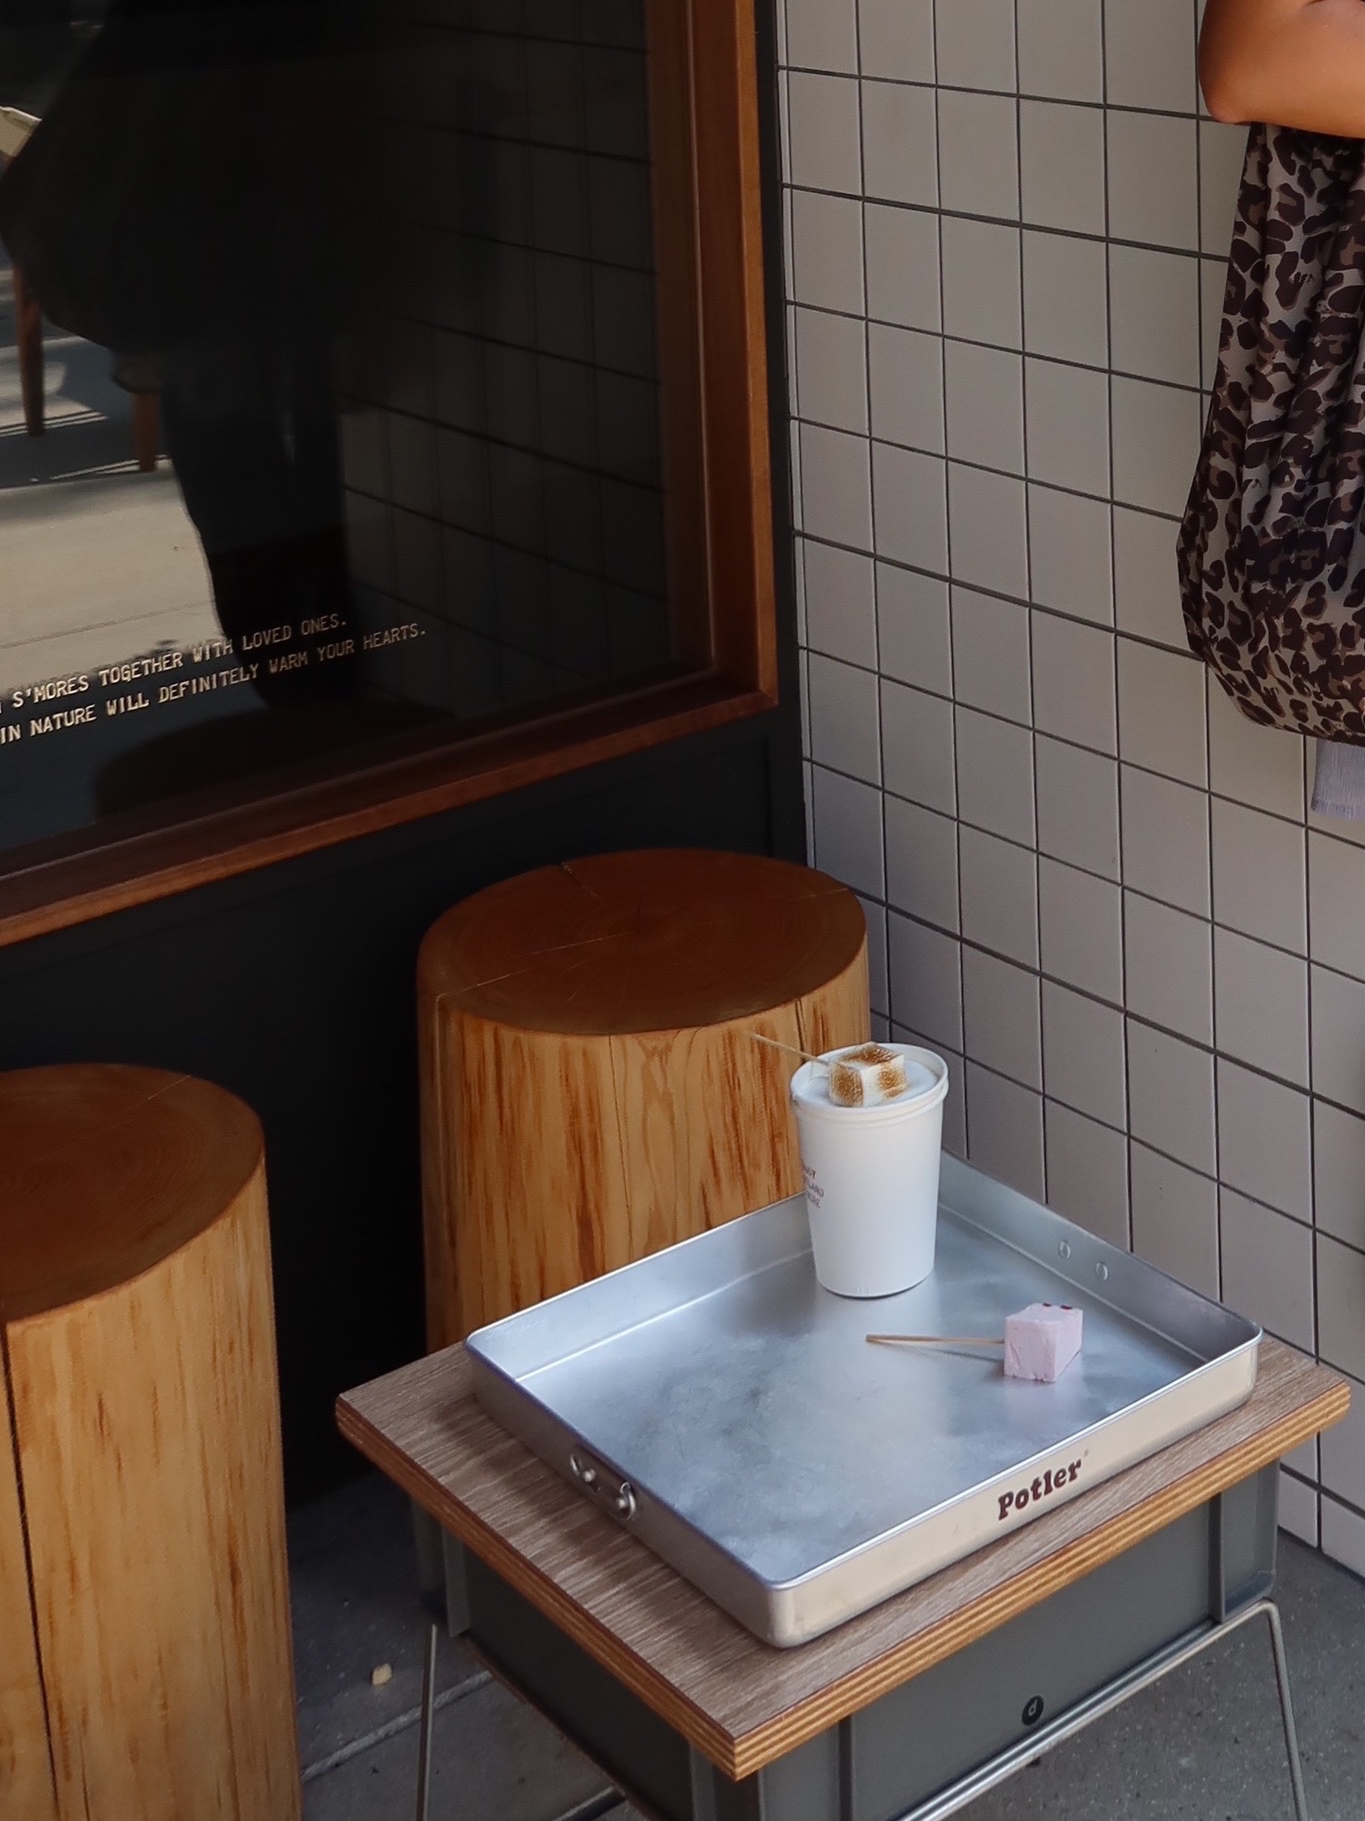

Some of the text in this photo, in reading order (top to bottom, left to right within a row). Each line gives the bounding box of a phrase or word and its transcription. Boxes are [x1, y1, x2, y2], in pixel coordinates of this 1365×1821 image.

[12, 674, 89, 708] S'MORES
[98, 652, 184, 687] TOGETHER
[192, 639, 233, 664] WITH
[242, 624, 292, 651] LOVED
[300, 612, 347, 636] ONES.
[30, 703, 97, 737] NATURE
[106, 692, 150, 717] WILL
[158, 663, 259, 704] DEFINITELY
[269, 651, 308, 674] WARM
[317, 638, 355, 662] YOUR
[363, 623, 426, 650] HEARTS.
[998, 1458, 1082, 1521] Potler
